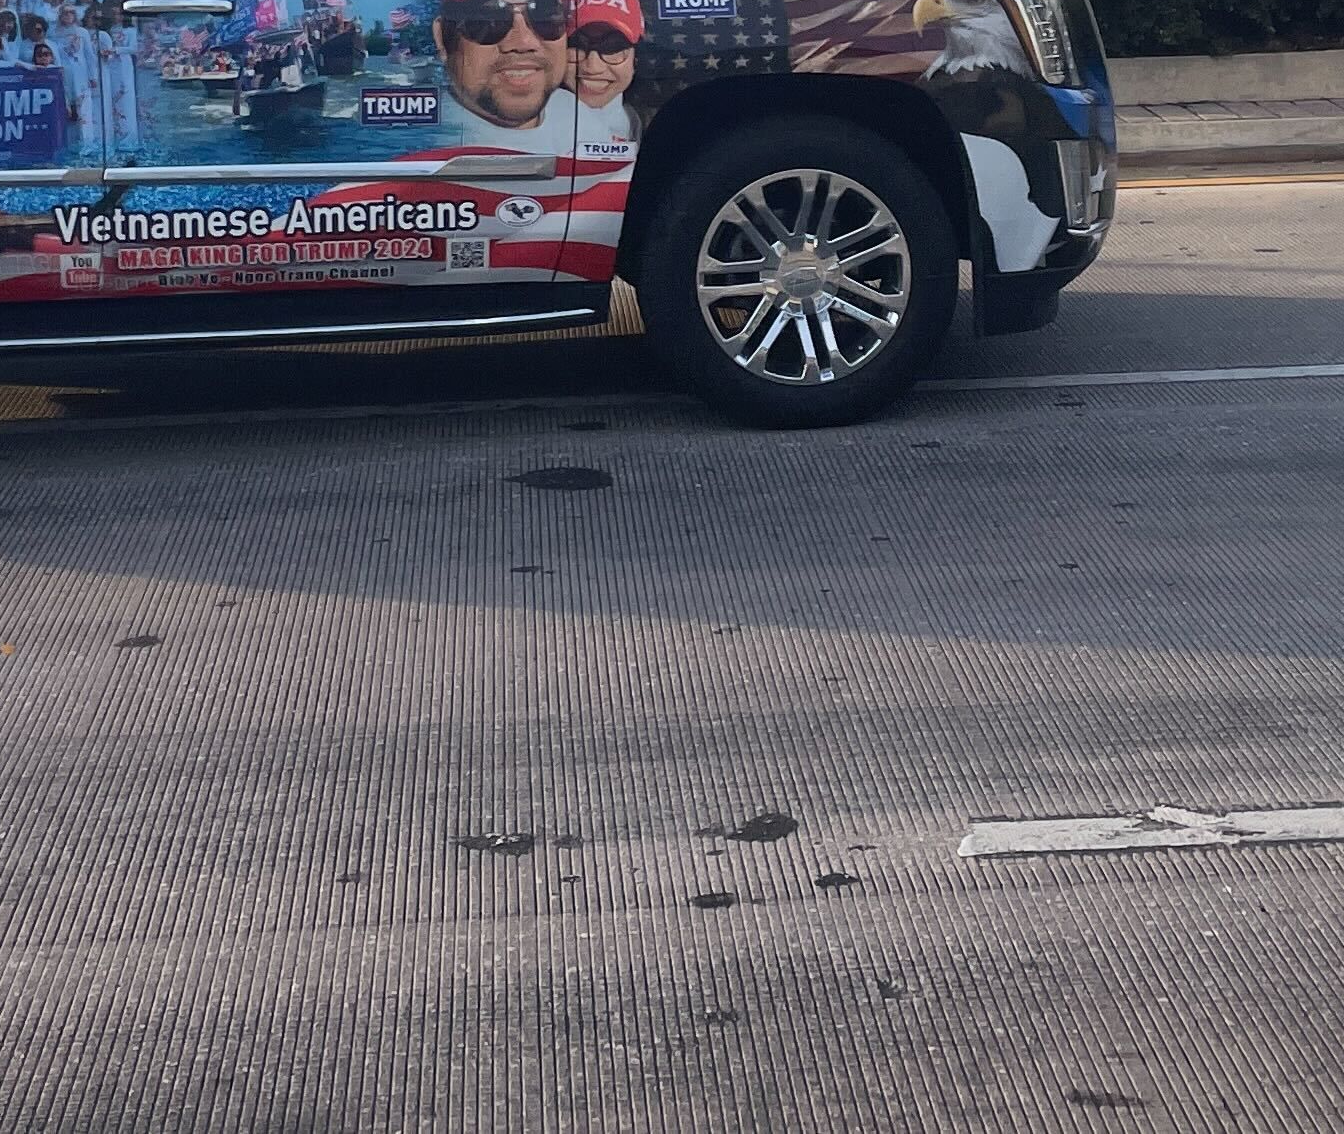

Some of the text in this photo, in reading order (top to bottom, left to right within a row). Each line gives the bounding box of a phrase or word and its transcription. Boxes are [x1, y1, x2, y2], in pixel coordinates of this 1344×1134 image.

[364, 96, 436, 114] TRUMP
[584, 144, 629, 153] TRUMP
[55, 196, 477, 243] Vietnamese Americans
[119, 238, 432, 268] MAGA KING FOR TRUMP 2024
[71, 255, 93, 267] You
[329, 267, 394, 280] Channel
